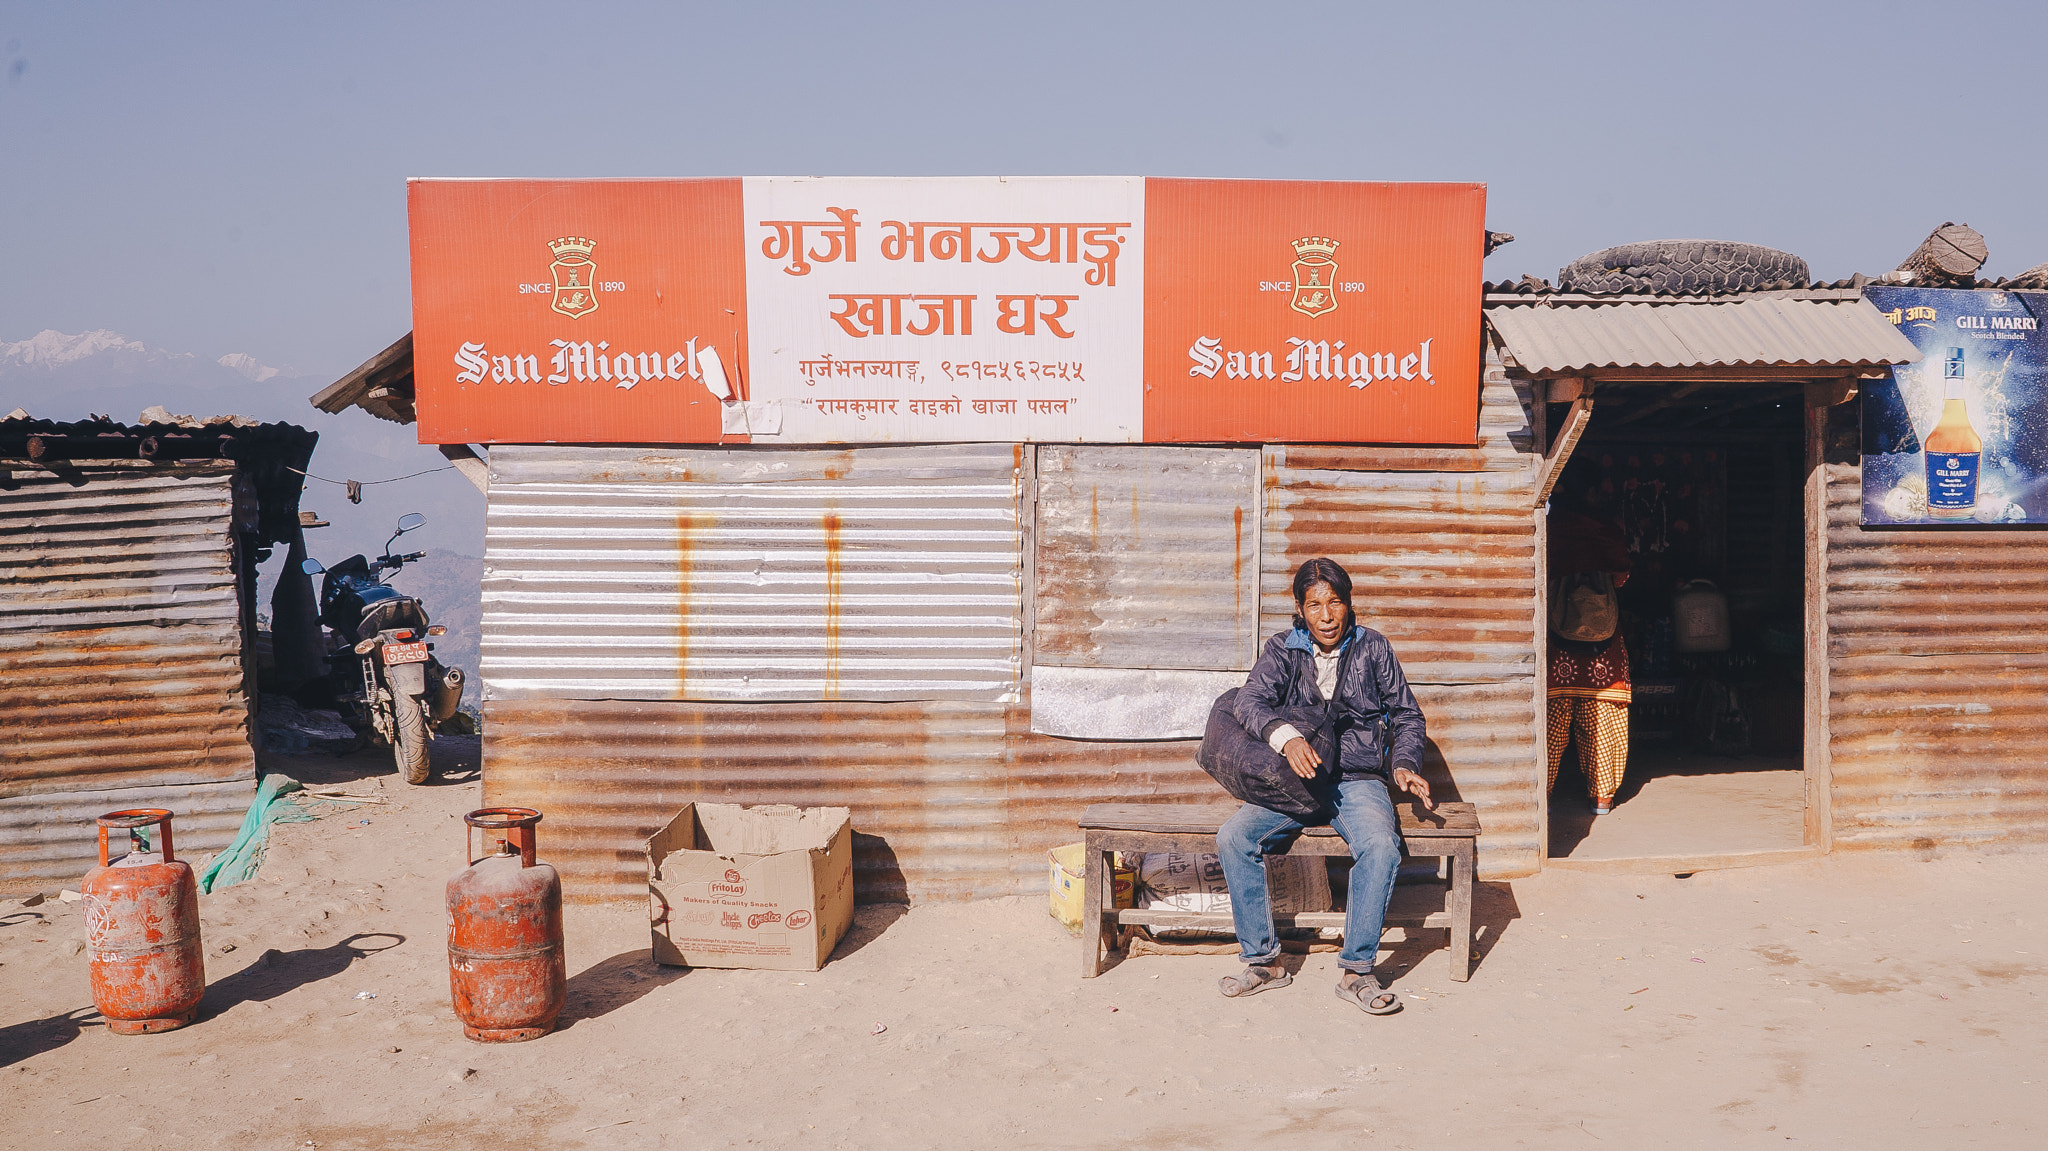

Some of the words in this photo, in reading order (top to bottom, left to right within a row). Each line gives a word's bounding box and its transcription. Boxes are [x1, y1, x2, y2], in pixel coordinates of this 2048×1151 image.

[760, 206, 861, 276] गुर्जे
[519, 282, 551, 294] SINCE
[598, 281, 625, 292] 1890
[1259, 281, 1291, 292] SINCE
[1339, 281, 1365, 293] 1890
[829, 294, 977, 338] खाजा
[996, 294, 1079, 338] घर
[1956, 316, 1987, 330] GILL
[1991, 317, 2039, 330] MARRY
[1971, 332, 1994, 340] Scotch
[453, 340, 542, 384] San
[548, 336, 703, 390] Miguel
[941, 360, 1086, 382] ९८१८५६२८५५
[1188, 335, 1277, 380] San
[1281, 336, 1434, 390] Miguel
[909, 395, 962, 415] दाइको
[972, 399, 1017, 415] खाजा
[683, 896, 710, 905] Makers
[721, 899, 748, 908] Quality
[748, 911, 781, 929] Cheetos
